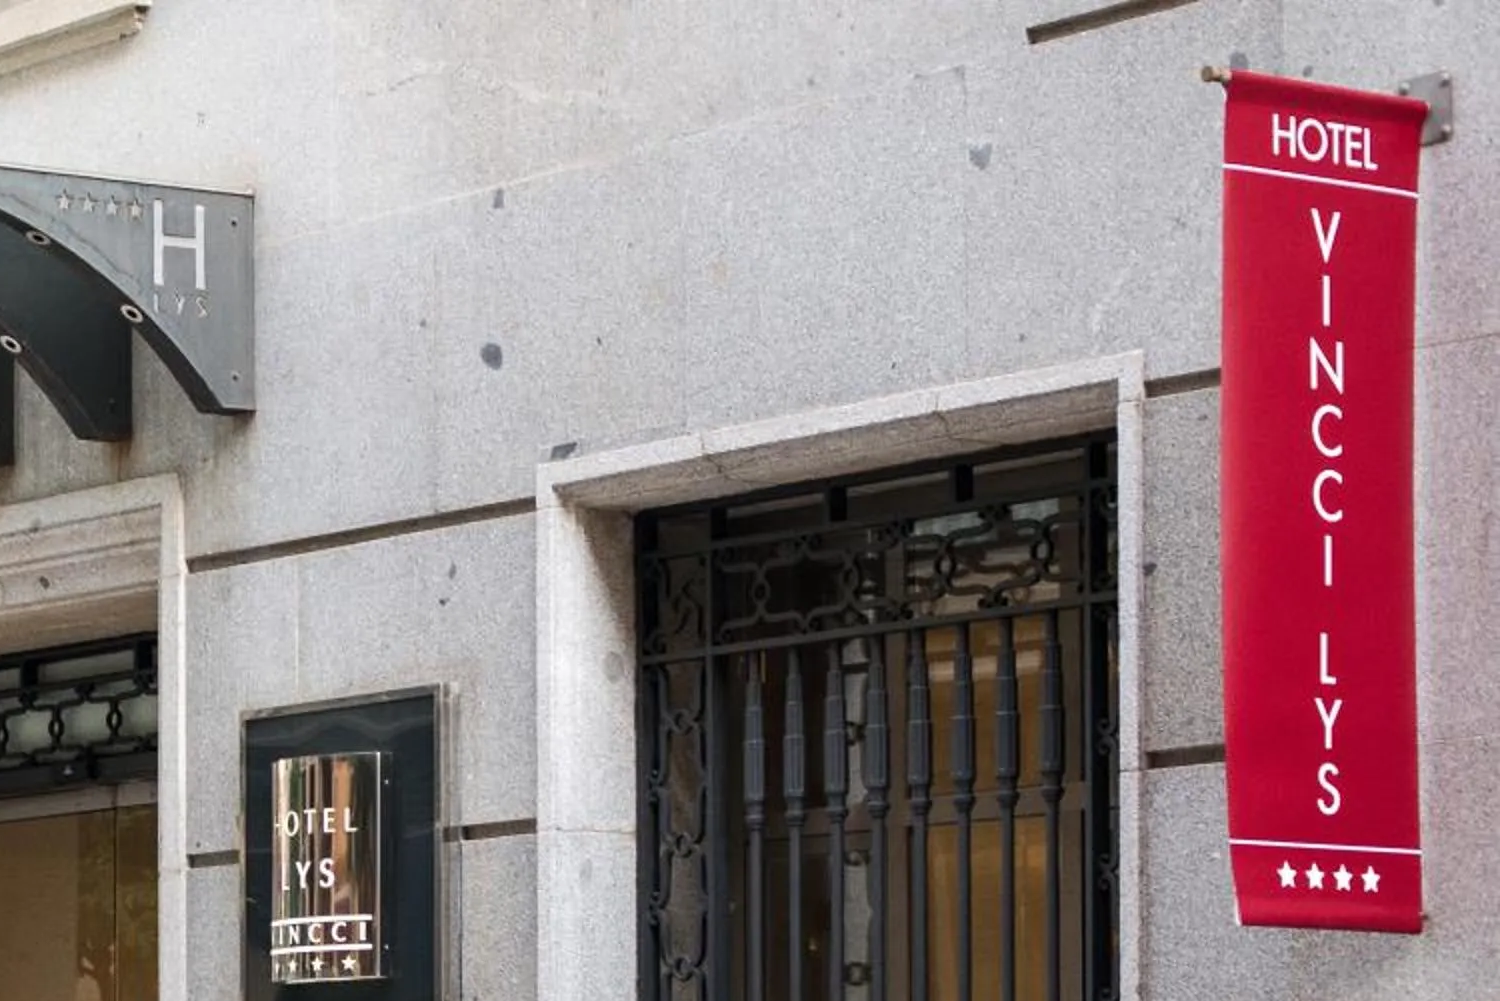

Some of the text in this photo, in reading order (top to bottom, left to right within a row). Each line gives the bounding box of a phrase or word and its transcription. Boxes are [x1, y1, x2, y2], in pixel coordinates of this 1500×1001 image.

[1271, 112, 1378, 170] HOTEL
[152, 199, 206, 290] H
[1308, 207, 1345, 816] VINCCI LYS
